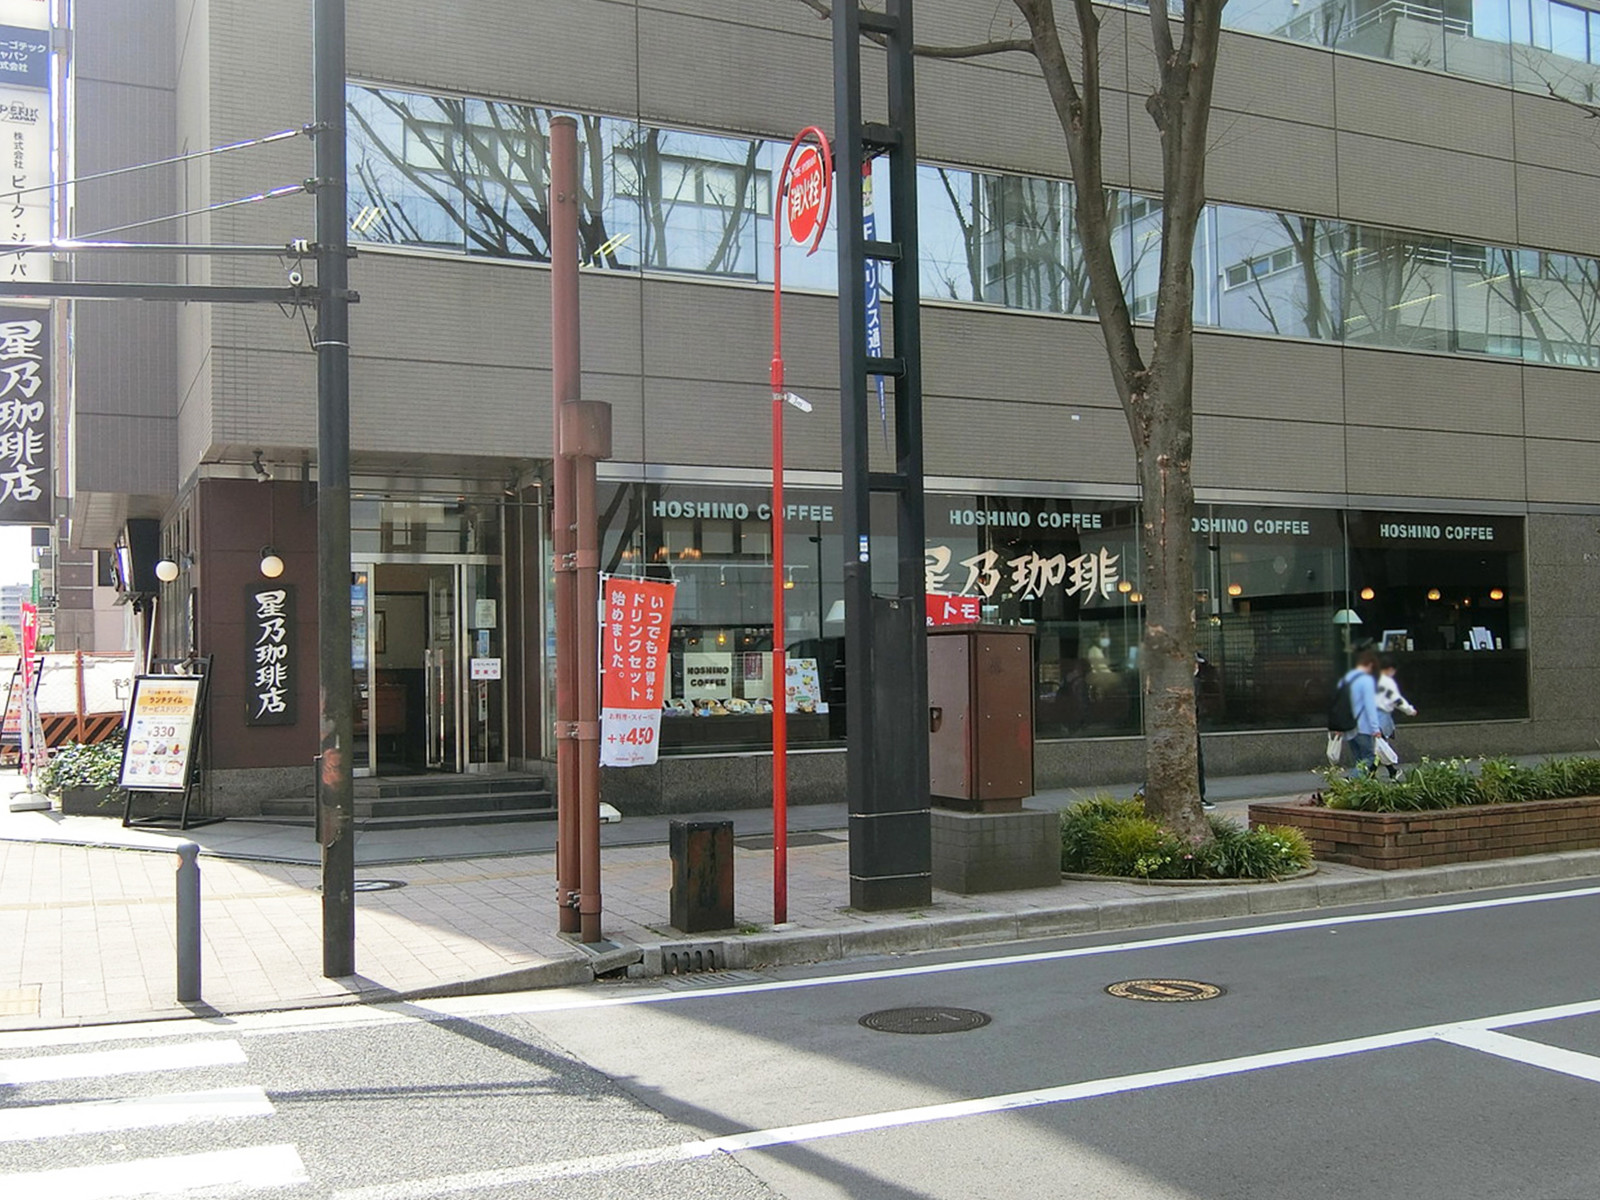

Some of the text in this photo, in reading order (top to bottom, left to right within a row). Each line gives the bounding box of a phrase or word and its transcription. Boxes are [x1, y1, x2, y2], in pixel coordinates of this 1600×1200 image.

[14, 131, 24, 169] 株式会社
[790, 169, 820, 222] 消火栓
[11, 175, 27, 282] ピーク・ジャパ
[0, 319, 45, 501] 星乃珈琲店
[653, 501, 834, 522] HOSHINO CFFEE
[950, 509, 1102, 529] HOSHINO COFFEE
[1191, 517, 1309, 535] OSHINO COFFEE
[1380, 523, 1494, 541] HOSHINO COFFEE
[254, 589, 289, 720] 星乃珈琲店
[610, 589, 626, 679] 始めました。
[628, 592, 646, 702] ドリンクセット
[645, 595, 665, 702] いつでもお得な
[687, 666, 729, 676] HOSHINO
[690, 678, 727, 687] COFFEE
